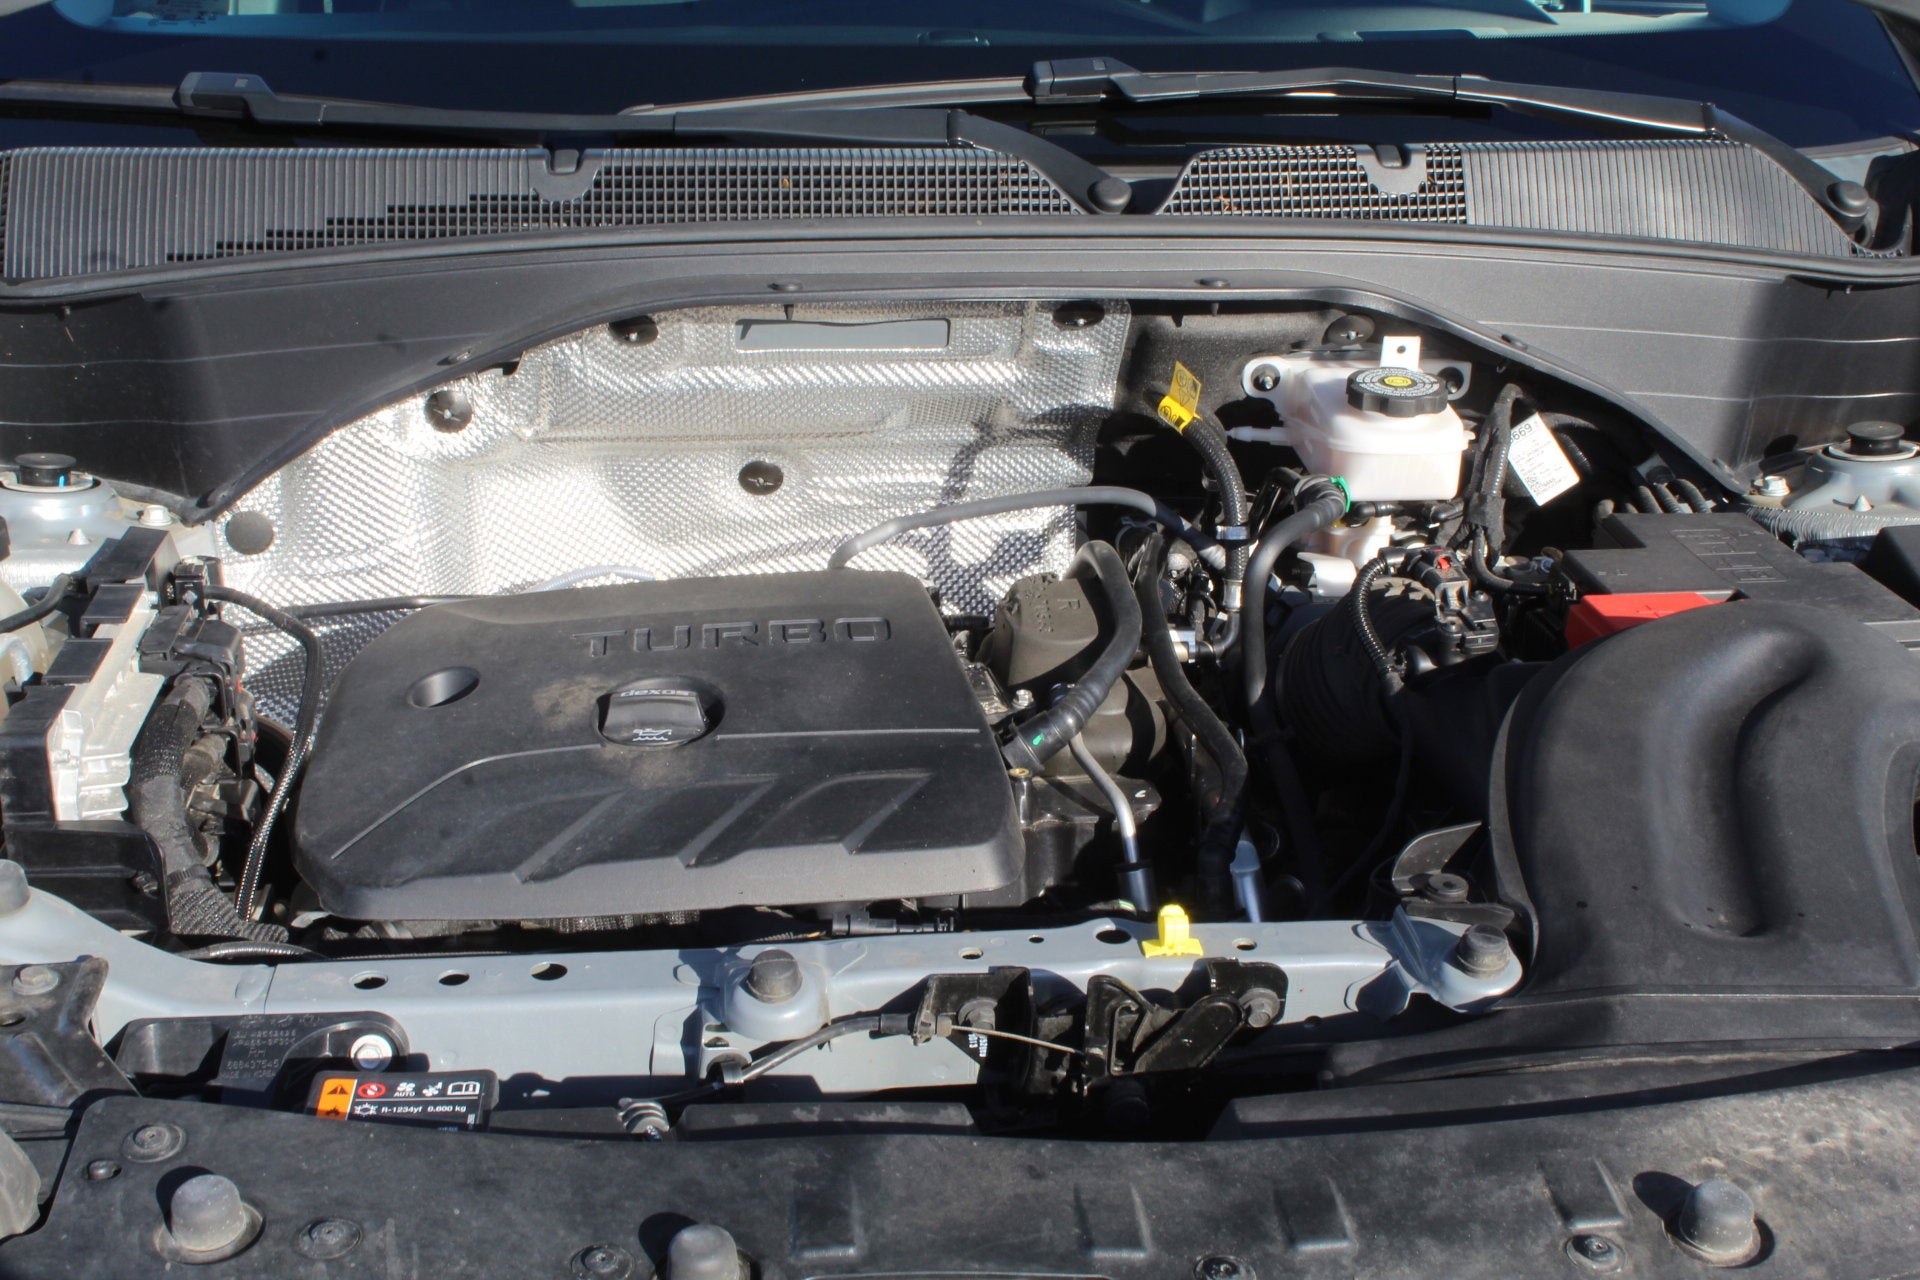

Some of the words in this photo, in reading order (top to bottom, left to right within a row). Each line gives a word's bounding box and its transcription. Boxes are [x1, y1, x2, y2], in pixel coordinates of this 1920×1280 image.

[572, 617, 891, 657] TURBO
[620, 689, 691, 697] dexos
[381, 1105, 422, 1114] R-1234yf
[455, 1104, 467, 1113] kg
